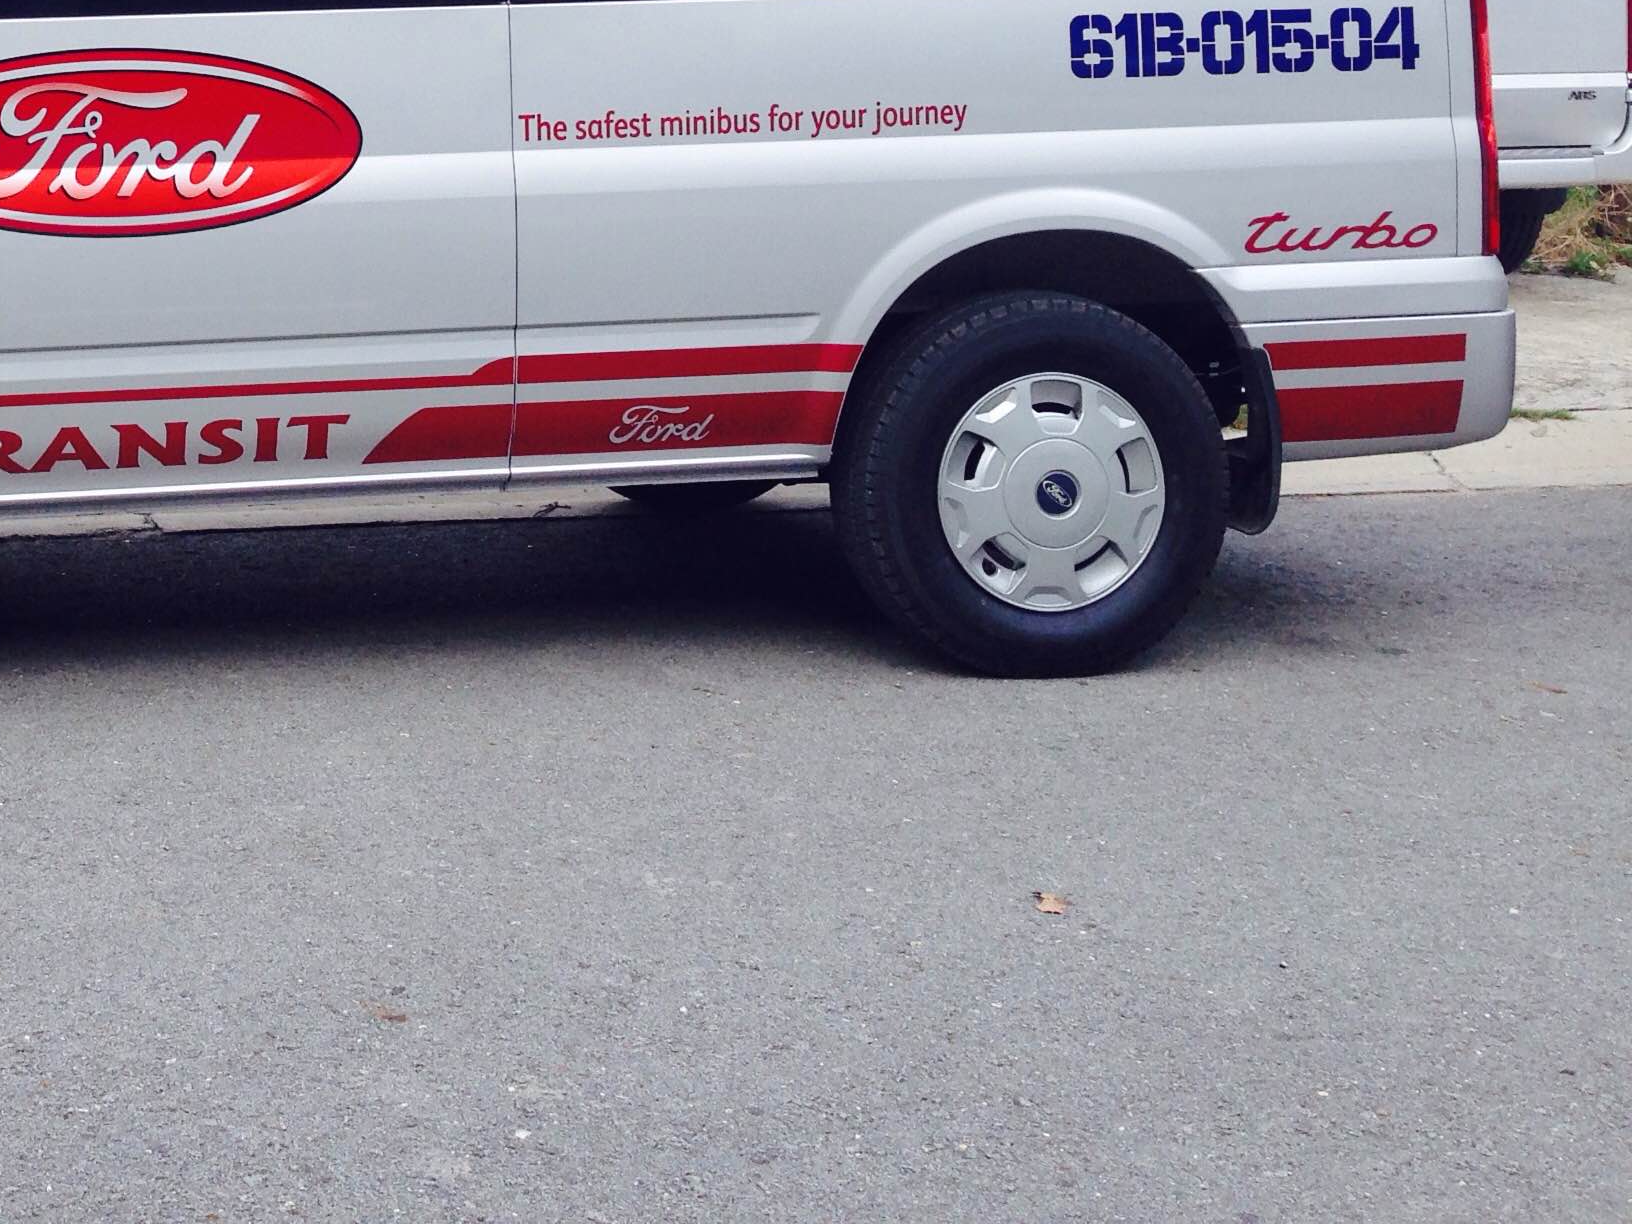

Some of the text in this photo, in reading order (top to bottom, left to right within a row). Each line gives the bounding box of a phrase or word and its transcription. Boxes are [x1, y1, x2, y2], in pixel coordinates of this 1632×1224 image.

[1069, 6, 1420, 79] 61B-015-04
[519, 101, 968, 142] The safest minibus for your journey
[1244, 211, 1439, 254] turbo
[608, 404, 716, 445] Ford
